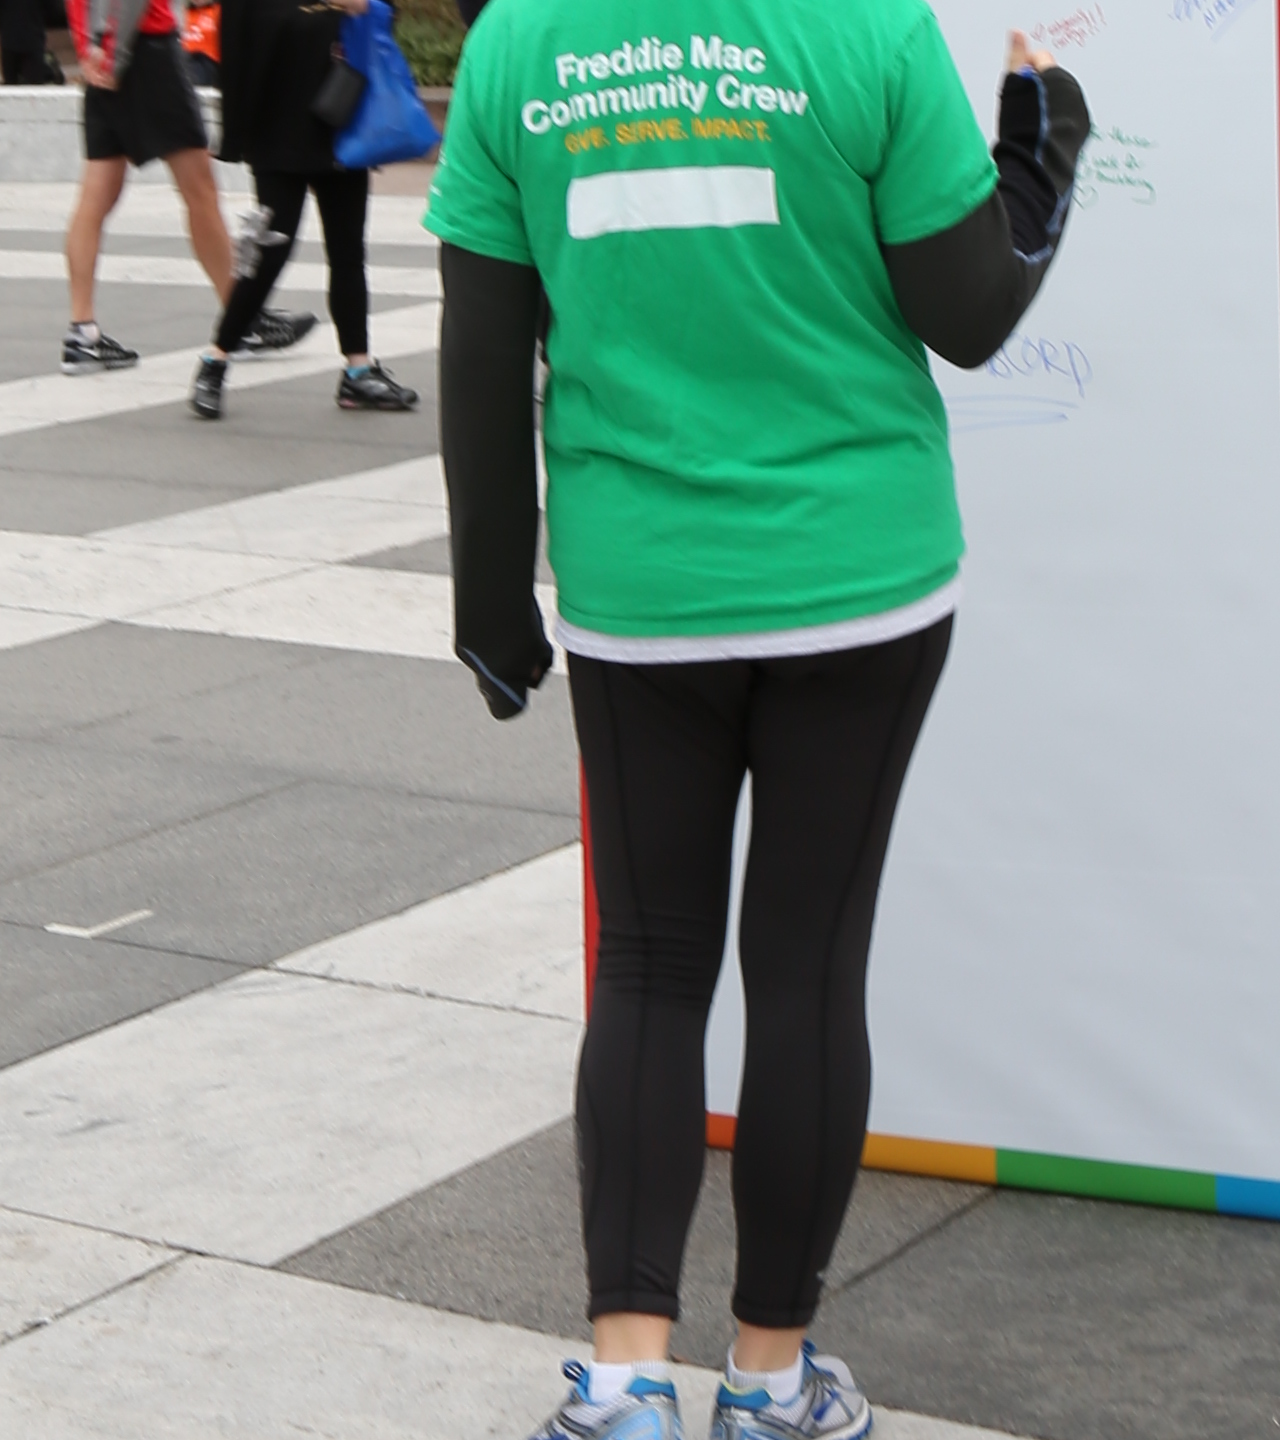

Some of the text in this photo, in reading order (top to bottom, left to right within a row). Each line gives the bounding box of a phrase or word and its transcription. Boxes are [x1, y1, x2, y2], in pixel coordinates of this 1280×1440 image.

[555, 34, 766, 89] Freddie Mac
[521, 73, 809, 135] Community Crew
